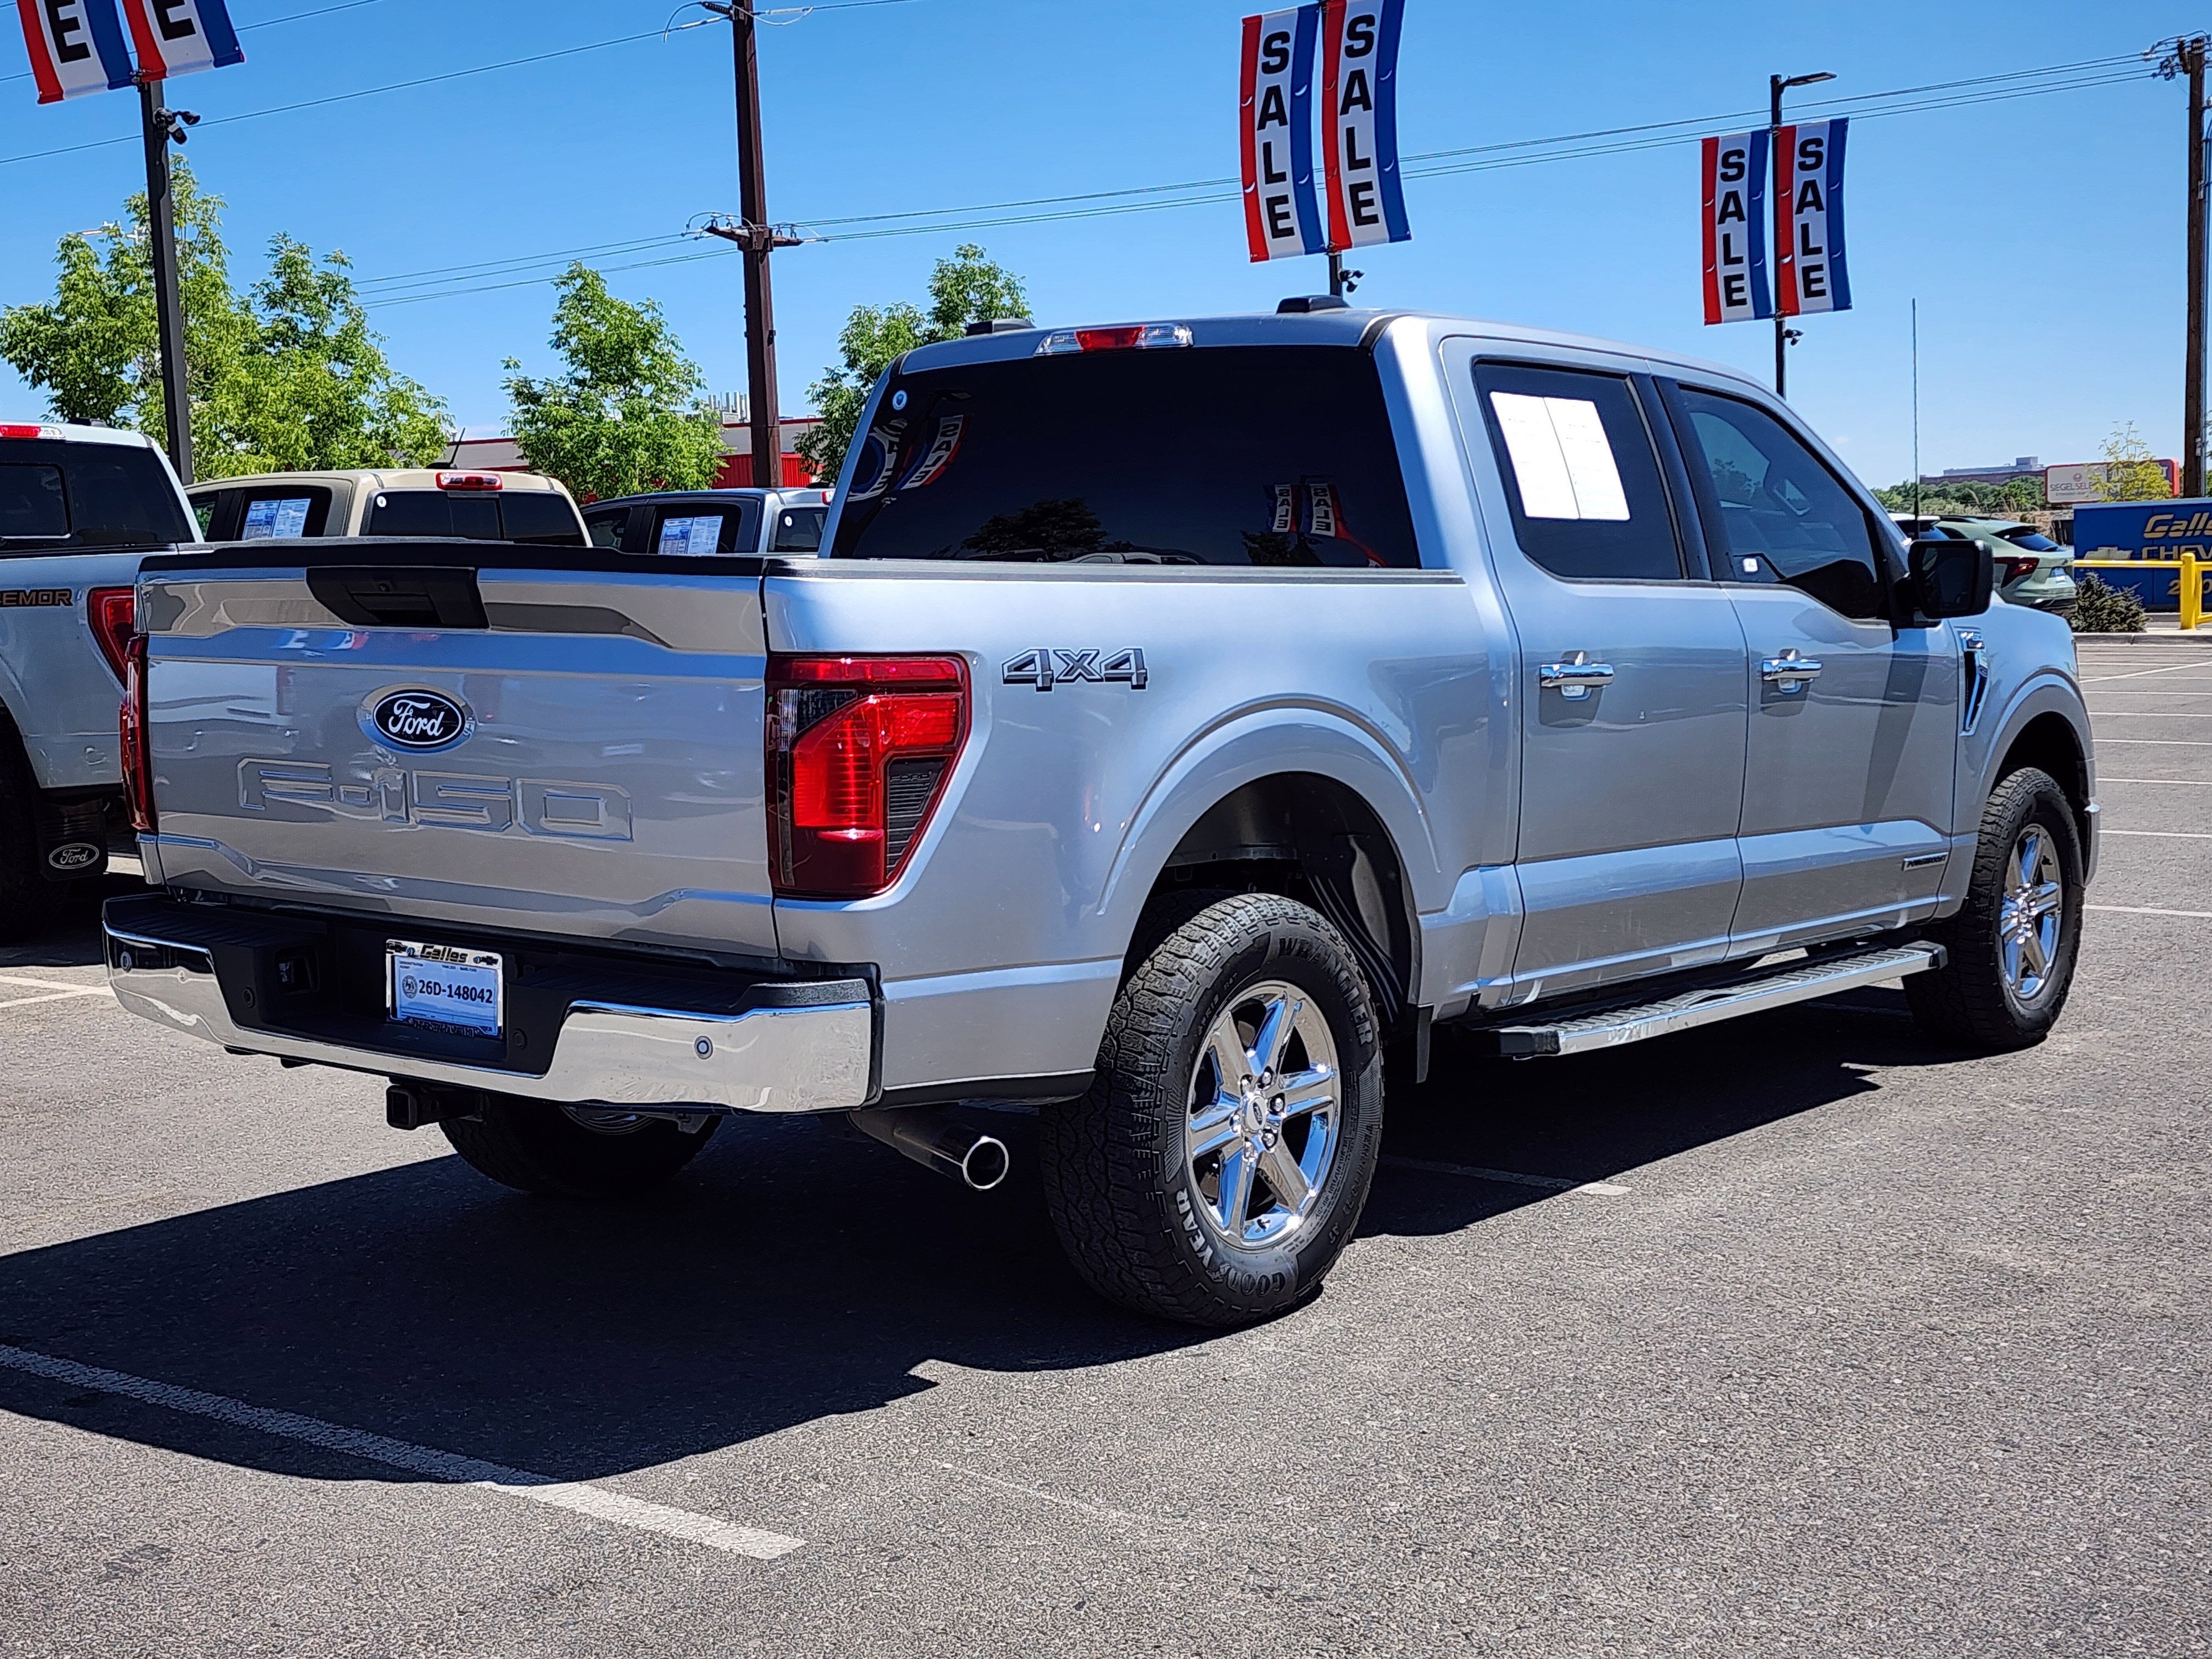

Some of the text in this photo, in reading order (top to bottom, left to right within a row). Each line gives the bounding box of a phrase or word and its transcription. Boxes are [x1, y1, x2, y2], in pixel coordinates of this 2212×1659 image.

[1256, 31, 1295, 239] SALE
[1339, 14, 1380, 227] SALE
[1717, 149, 1747, 307] SALE
[1794, 137, 1827, 299] SALE
[0, 590, 72, 607] EMOR
[388, 698, 445, 737] Ford
[237, 758, 634, 842] F-150
[60, 848, 88, 864] Ford
[419, 979, 493, 1004] 26D-148042
[420, 945, 468, 963] Galles
[1278, 936, 1374, 1047] WRANGLER
[1175, 1187, 1287, 1297] GOODYEAR
